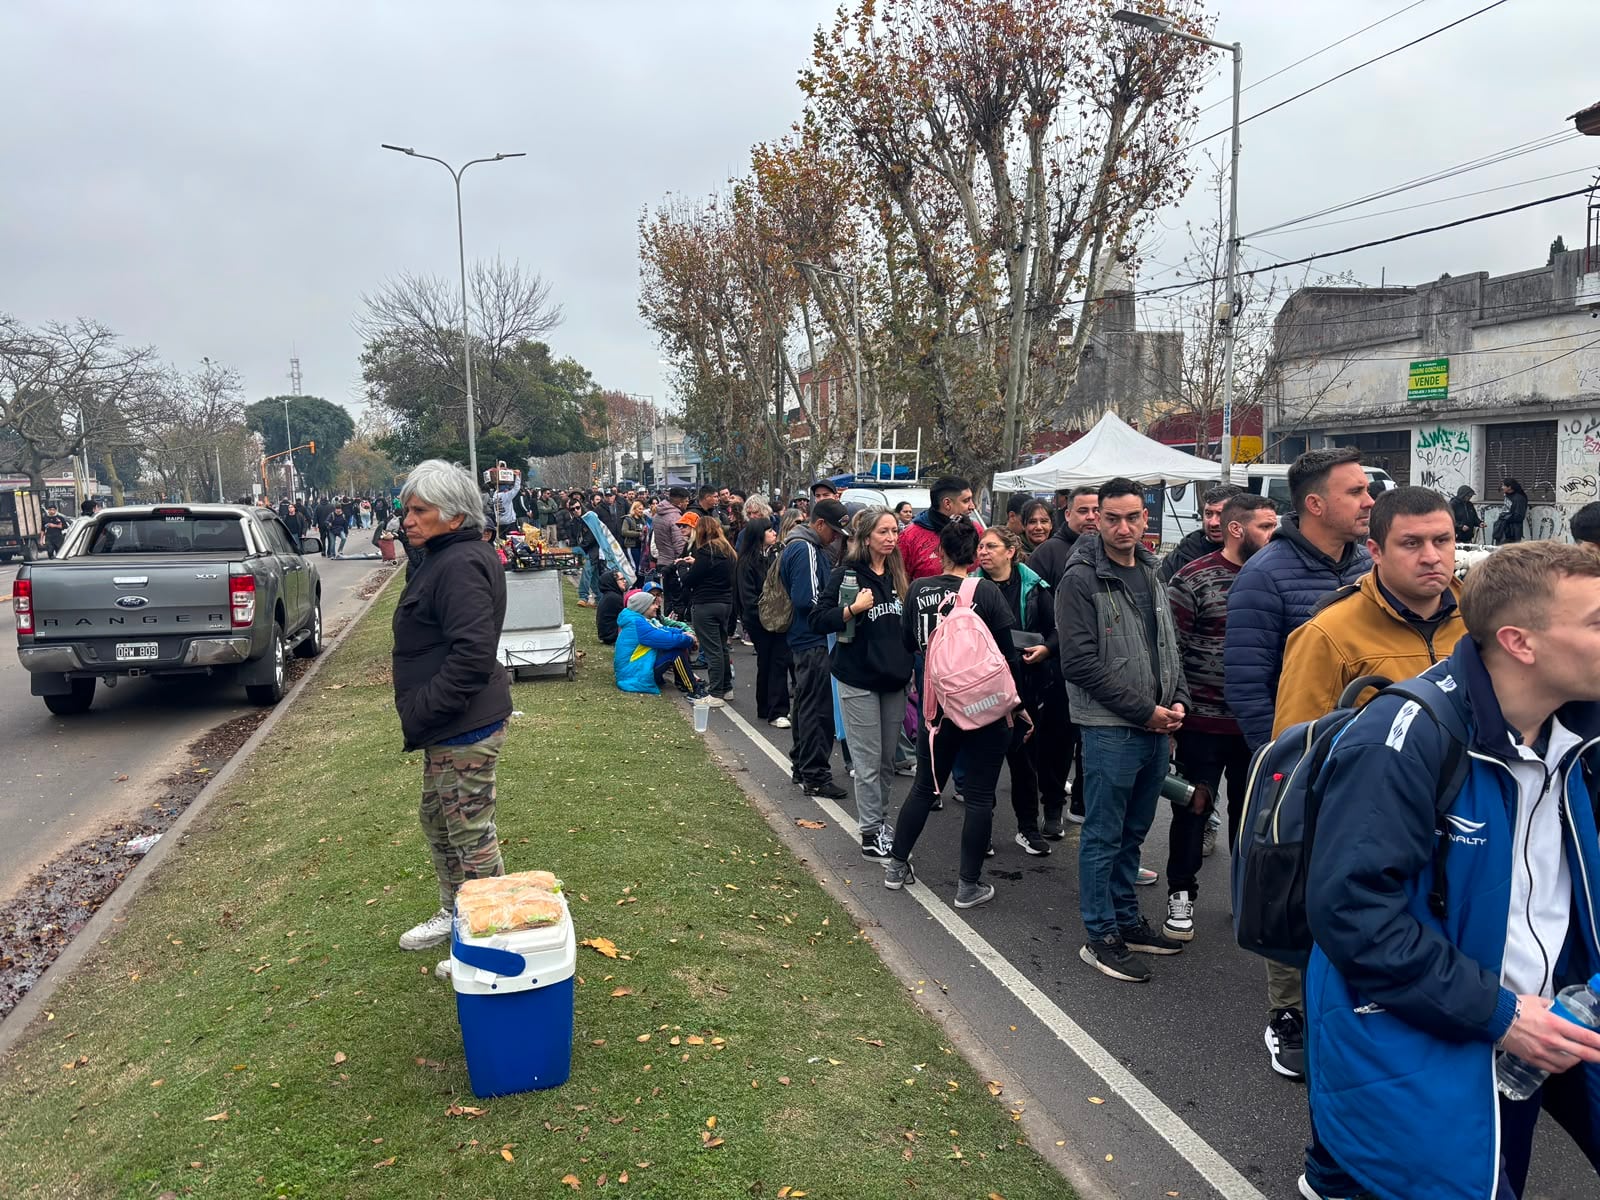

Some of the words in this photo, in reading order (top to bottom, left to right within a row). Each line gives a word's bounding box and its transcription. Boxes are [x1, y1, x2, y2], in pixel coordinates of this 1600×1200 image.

[1414, 375, 1440, 387] VENDE
[916, 593, 942, 610] INDIO
[43, 613, 224, 627] RANGER
[117, 647, 135, 657] ORW
[139, 646, 157, 656] 809
[963, 693, 999, 717] PUMA
[1434, 829, 1487, 846] PNALTY
